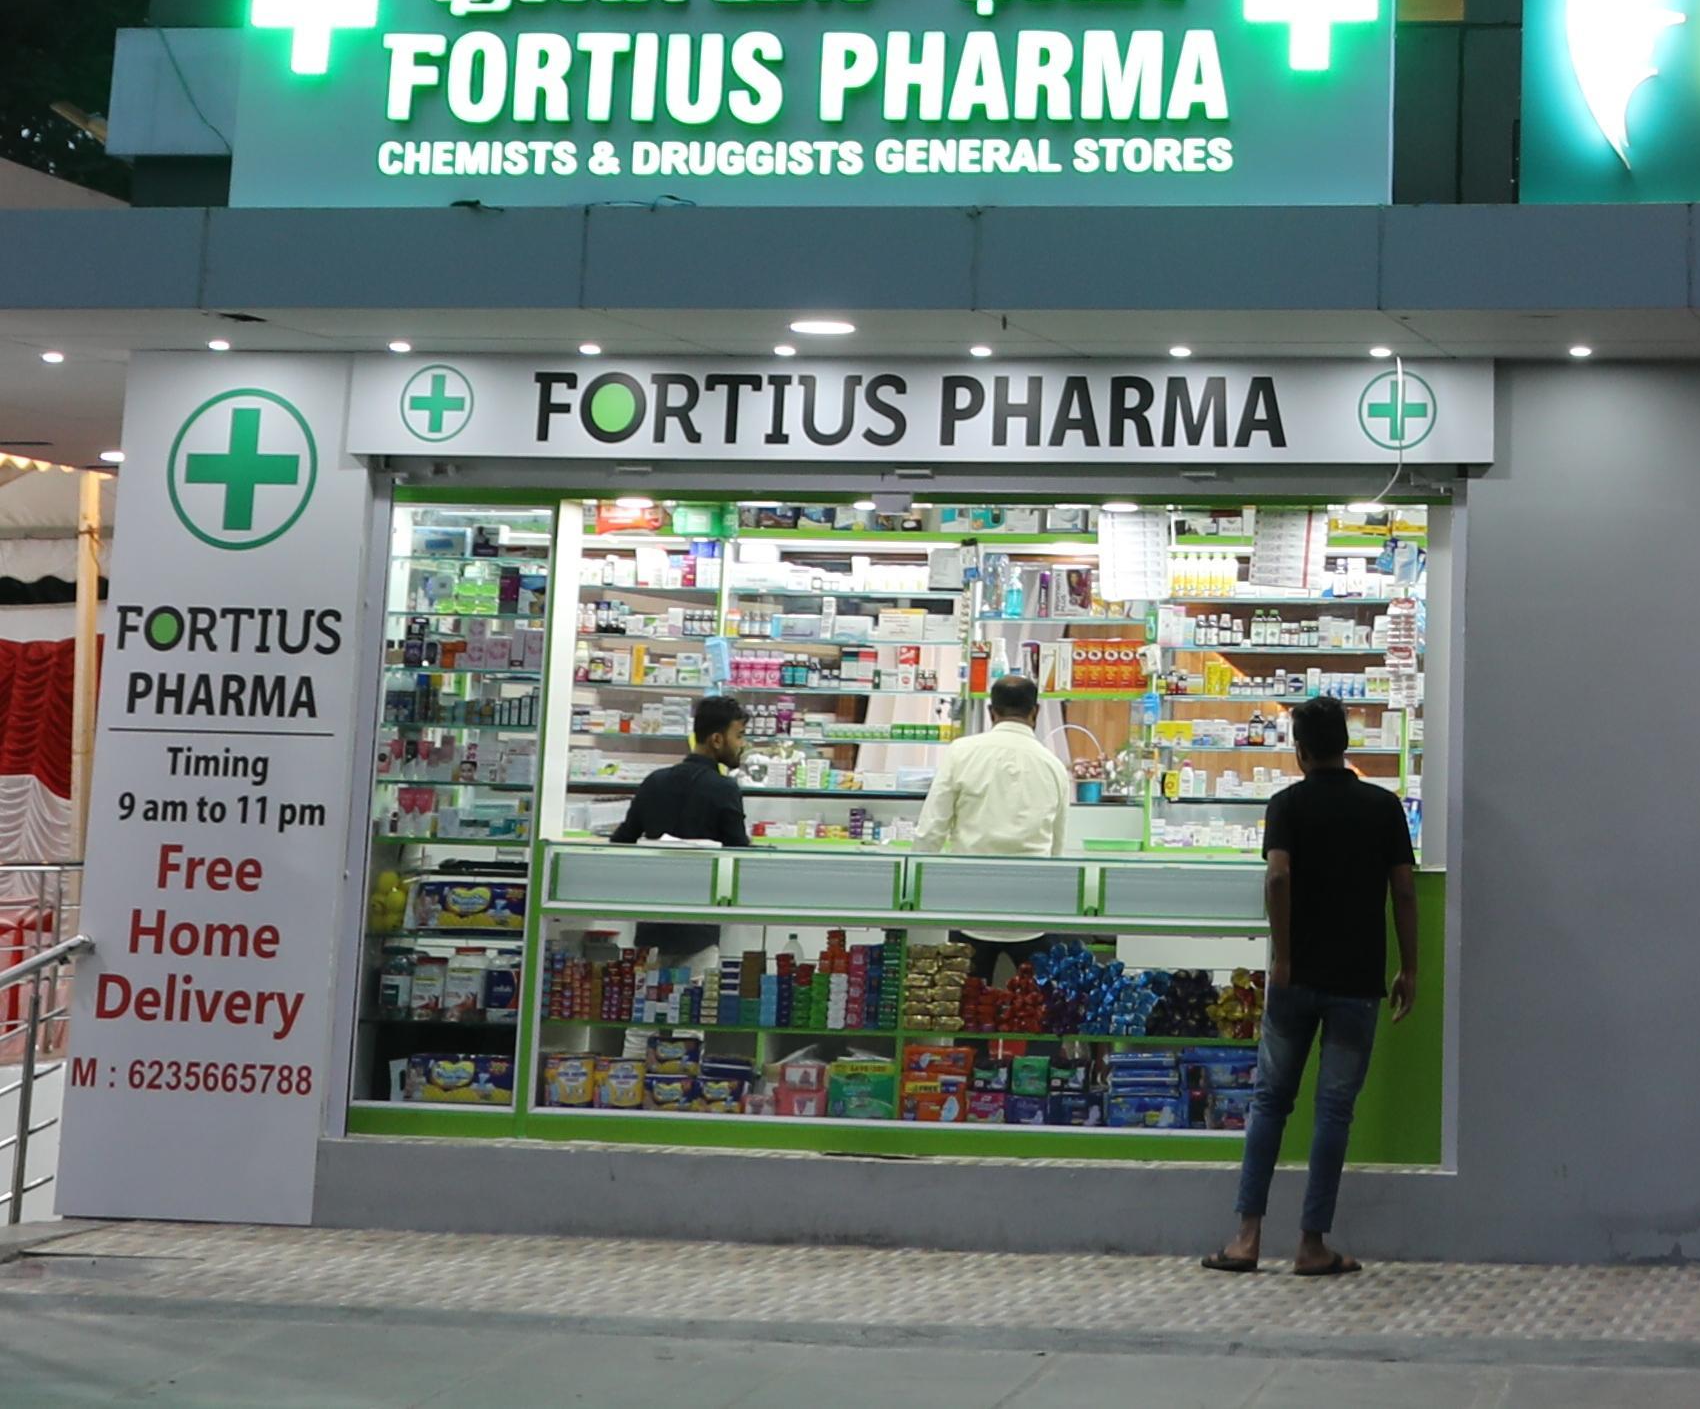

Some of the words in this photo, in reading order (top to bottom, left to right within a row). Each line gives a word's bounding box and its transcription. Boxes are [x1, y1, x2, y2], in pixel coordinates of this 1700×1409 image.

[383, 31, 783, 124] FORTIUS
[820, 30, 1229, 121] PHARMA
[378, 141, 577, 175] CHEMISTS
[588, 141, 620, 174] &
[632, 137, 863, 175] DRUGGISTS
[875, 138, 1062, 174] GENERAL
[1073, 137, 1233, 172] STORES
[534, 371, 907, 446] FORTIUS
[940, 376, 1287, 448] PHARMA
[117, 605, 342, 655] FORTIUS
[126, 672, 318, 718] PHARMA
[167, 746, 269, 786] Timing
[119, 792, 136, 820] 9
[143, 798, 187, 822] am
[197, 796, 226, 823] to
[237, 796, 268, 824] 11
[278, 802, 326, 833] pm
[157, 844, 263, 892] Free
[129, 909, 280, 959] Home
[95, 973, 305, 1040] Delivery
[71, 1057, 97, 1087] M
[128, 1059, 313, 1095] 6235665788
